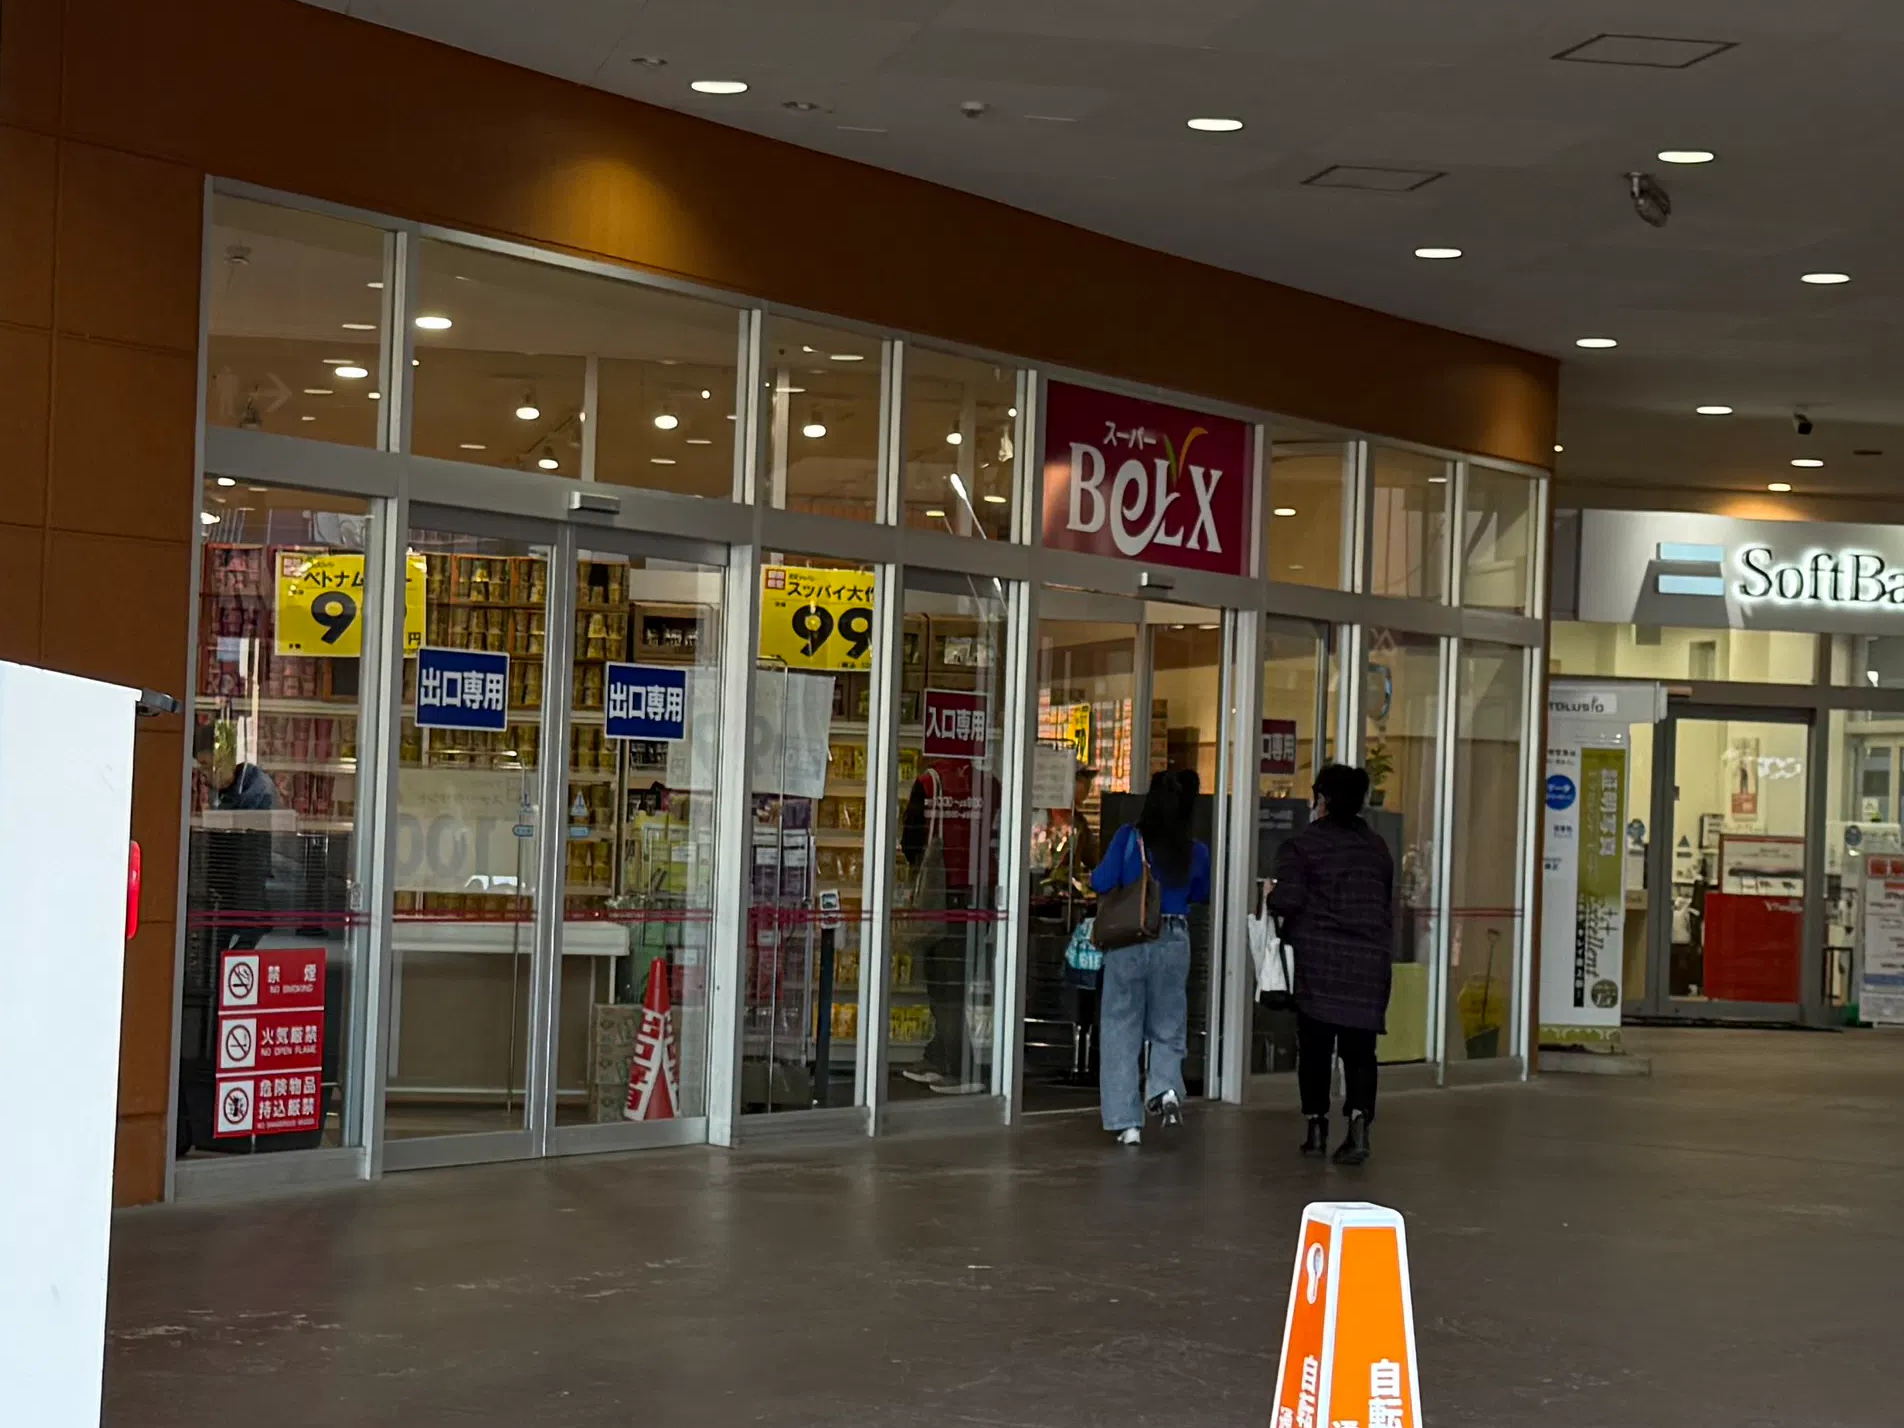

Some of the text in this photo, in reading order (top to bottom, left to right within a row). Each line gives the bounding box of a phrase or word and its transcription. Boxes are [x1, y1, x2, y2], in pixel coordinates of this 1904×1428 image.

[1103, 421, 1156, 450] スーパー
[792, 604, 873, 660] 99
[419, 667, 504, 712] 出口専用
[609, 681, 684, 723] 出口専用
[926, 706, 986, 742] 入口専用
[1261, 732, 1295, 761] 口専用
[261, 1025, 317, 1046] 火気厳禁
[260, 1076, 316, 1098] 危険物品
[259, 1098, 315, 1120] 持込厳禁
